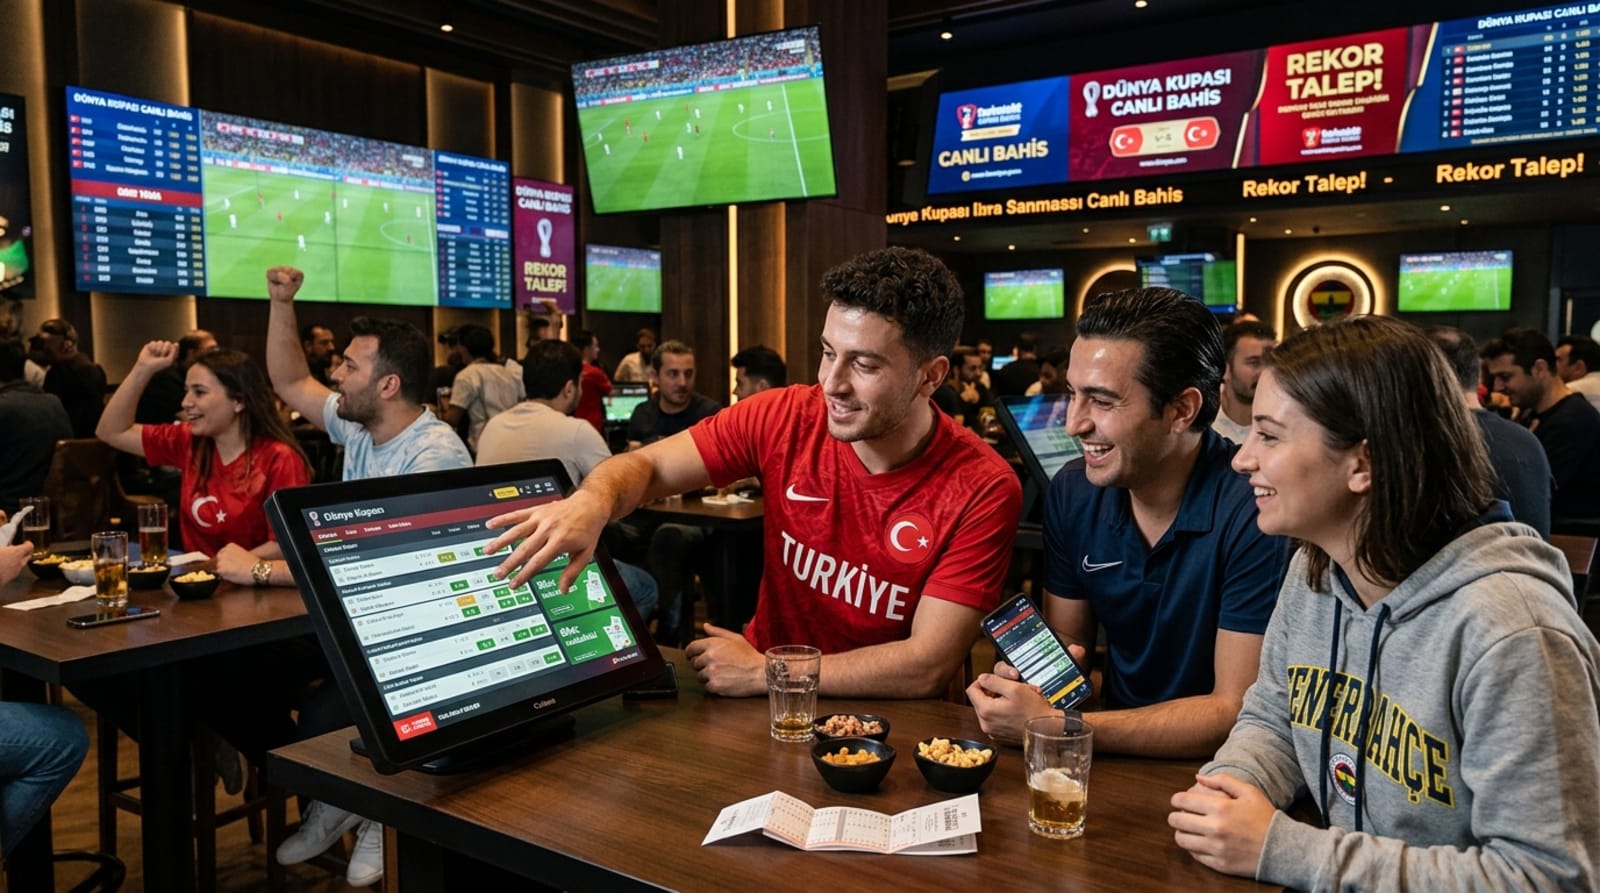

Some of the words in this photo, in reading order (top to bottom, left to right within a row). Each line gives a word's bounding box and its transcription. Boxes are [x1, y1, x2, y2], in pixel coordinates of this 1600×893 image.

[1287, 42, 1384, 76] REKOR
[1102, 78, 1163, 100] DÜNYA
[1166, 68, 1232, 91] KUPASI
[1285, 68, 1383, 100] TALEP!
[1111, 96, 1163, 117] CANLI
[1166, 89, 1221, 110] BAHİS
[938, 147, 990, 168] CANLI
[993, 137, 1049, 161] BAHİS
[921, 205, 970, 223] Kupası
[1086, 190, 1129, 209] Canlı
[1133, 186, 1184, 206] Bahis
[1242, 178, 1300, 198] Rekor
[1304, 170, 1367, 194] Talep!
[1436, 162, 1505, 184] Rekor
[1510, 152, 1585, 178] Talep!
[524, 261, 567, 278] REKOR
[524, 276, 567, 293] TALEP!
[1287, 664, 1456, 809] ENERAHÇE
